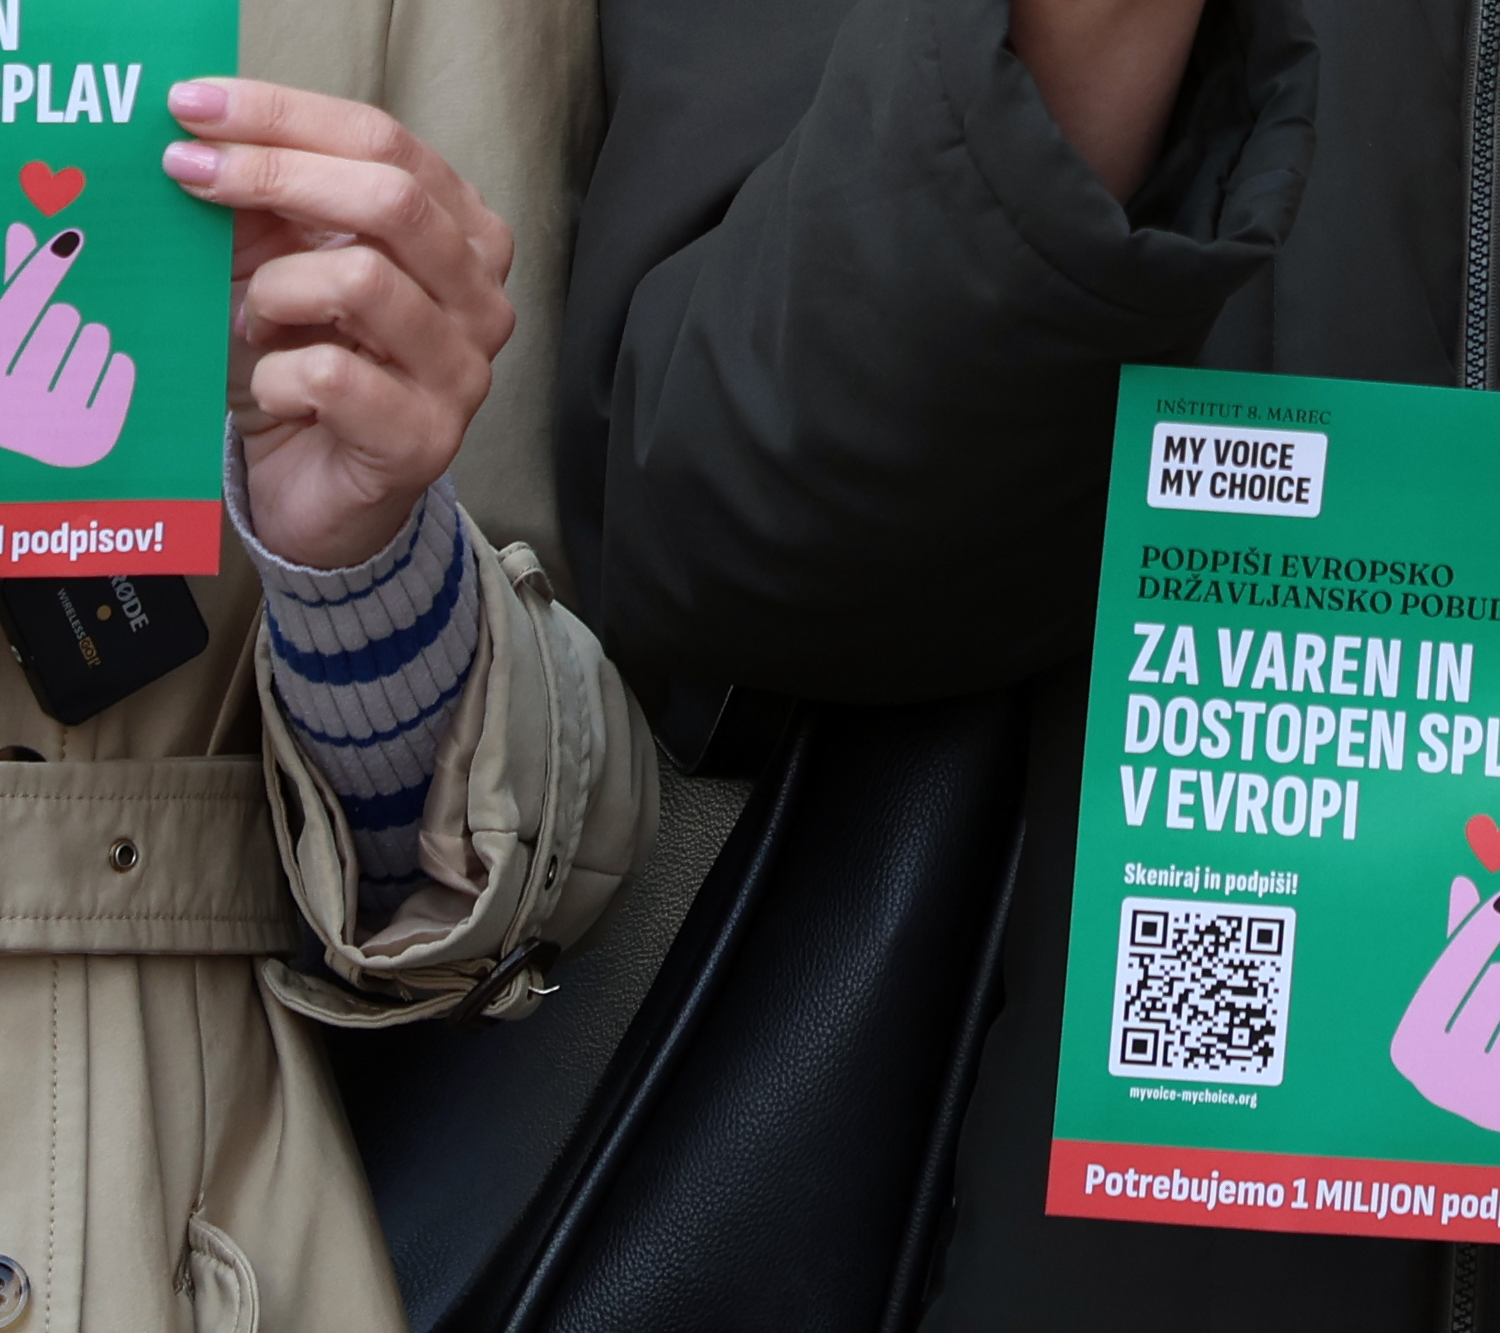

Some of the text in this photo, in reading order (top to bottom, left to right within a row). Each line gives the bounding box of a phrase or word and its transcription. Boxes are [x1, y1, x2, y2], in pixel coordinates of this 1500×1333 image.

[1156, 398, 1332, 426] INŠTITUT 8. MAREC
[1163, 436, 1295, 470] MY VOICE
[1160, 469, 1312, 505] MY CHOICE
[11, 521, 164, 561] podpisov!
[1141, 545, 1455, 589] PODPIŠI EVROPSKO
[57, 587, 87, 641] WIRELESS
[1137, 573, 1393, 616] DRŽAVLJANSKO
[1128, 622, 1474, 703] ZA VAREN IN
[1123, 694, 1405, 771] DOSTOPEN
[1119, 765, 1359, 840] V EVROPI
[1124, 863, 1298, 898] Skeniraj in podpiši!
[1129, 1085, 1257, 1109] myvoice-mychoice.org
[1084, 1163, 1286, 1209] Potrebujemo
[1290, 1178, 1309, 1209] 1
[1315, 1179, 1435, 1219] MILIJON
